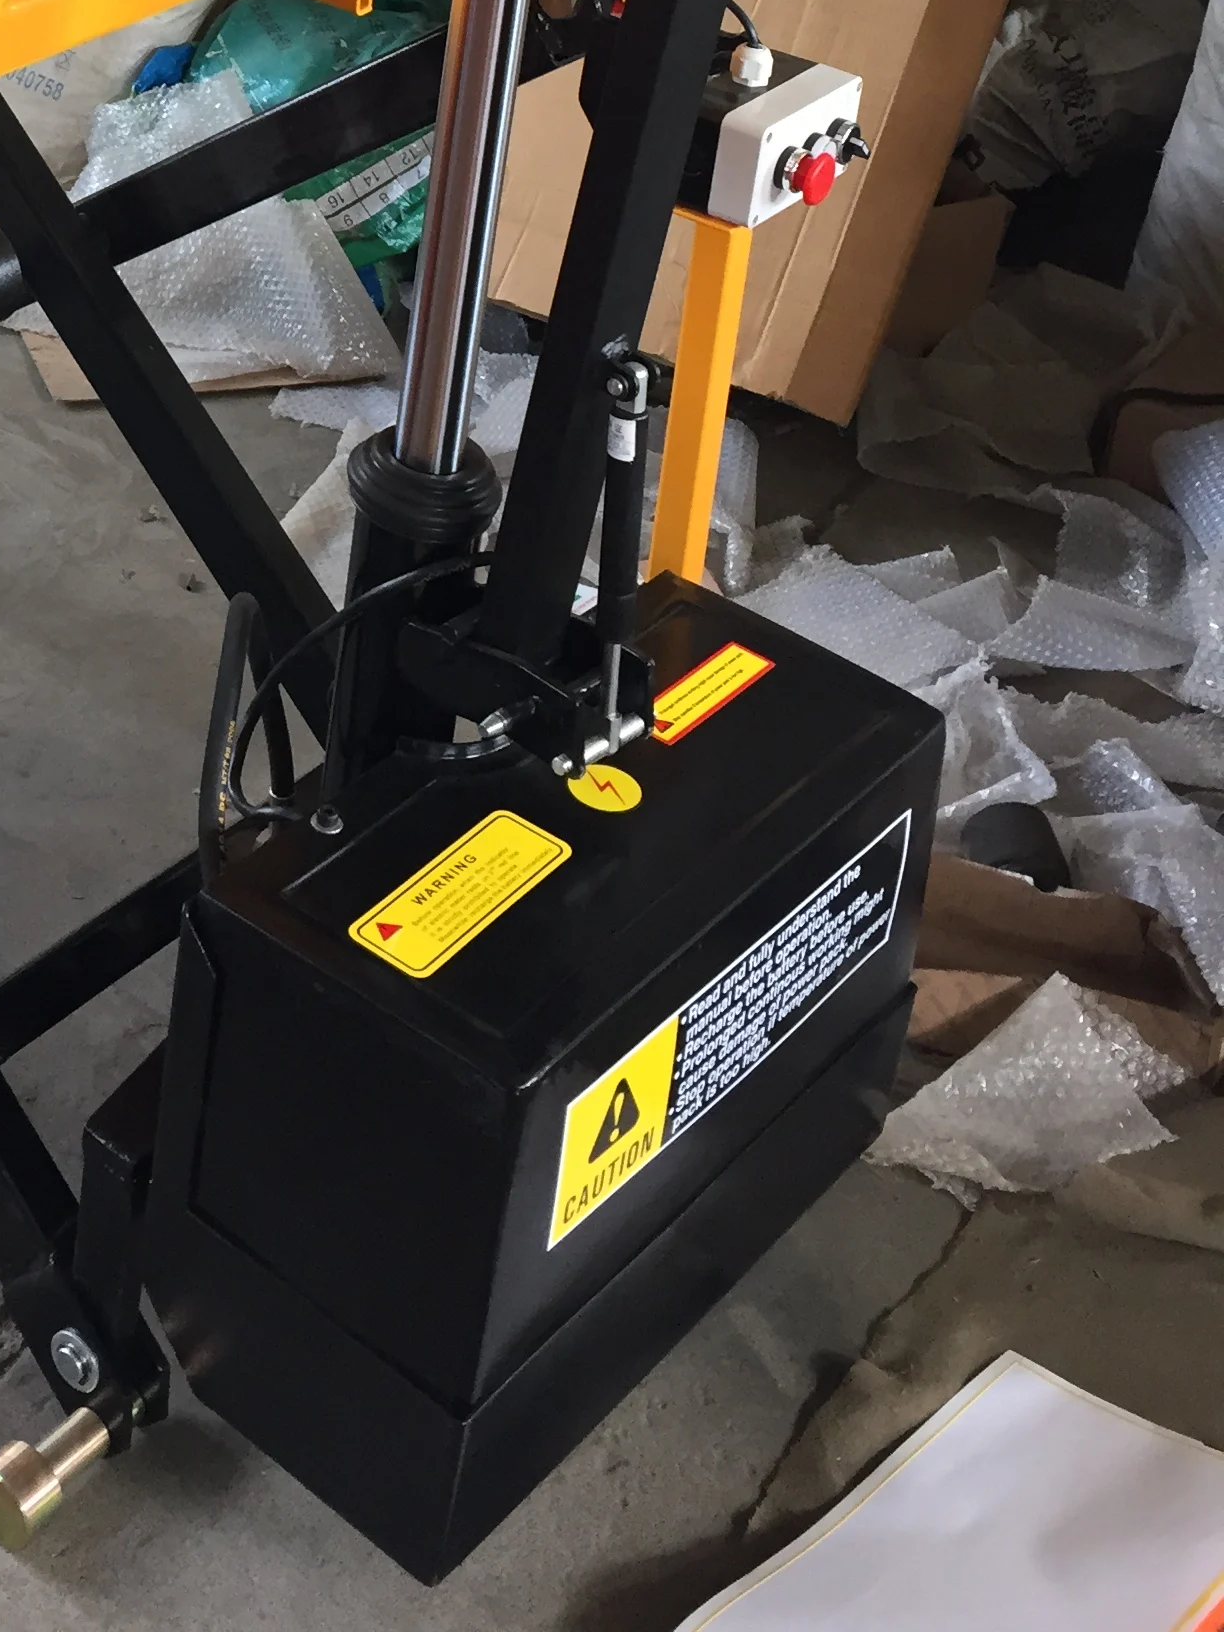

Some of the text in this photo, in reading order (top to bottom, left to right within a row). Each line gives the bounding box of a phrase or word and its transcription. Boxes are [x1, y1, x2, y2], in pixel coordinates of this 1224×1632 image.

[326, 191, 346, 209] 16
[362, 169, 381, 188] 14
[410, 853, 478, 906] WARNING
[688, 864, 862, 1024] Read and fully understand the
[675, 908, 892, 1113] Stop operation if temperature of power
[678, 937, 849, 1095] cause damage of power pack.
[681, 887, 885, 1078] Prolonged continous working might
[683, 890, 870, 1060] Recharge the battery before use.
[685, 908, 833, 1043] manual before operation.
[671, 1036, 771, 1135] pack is too high.
[563, 1125, 656, 1225] CAUTION
